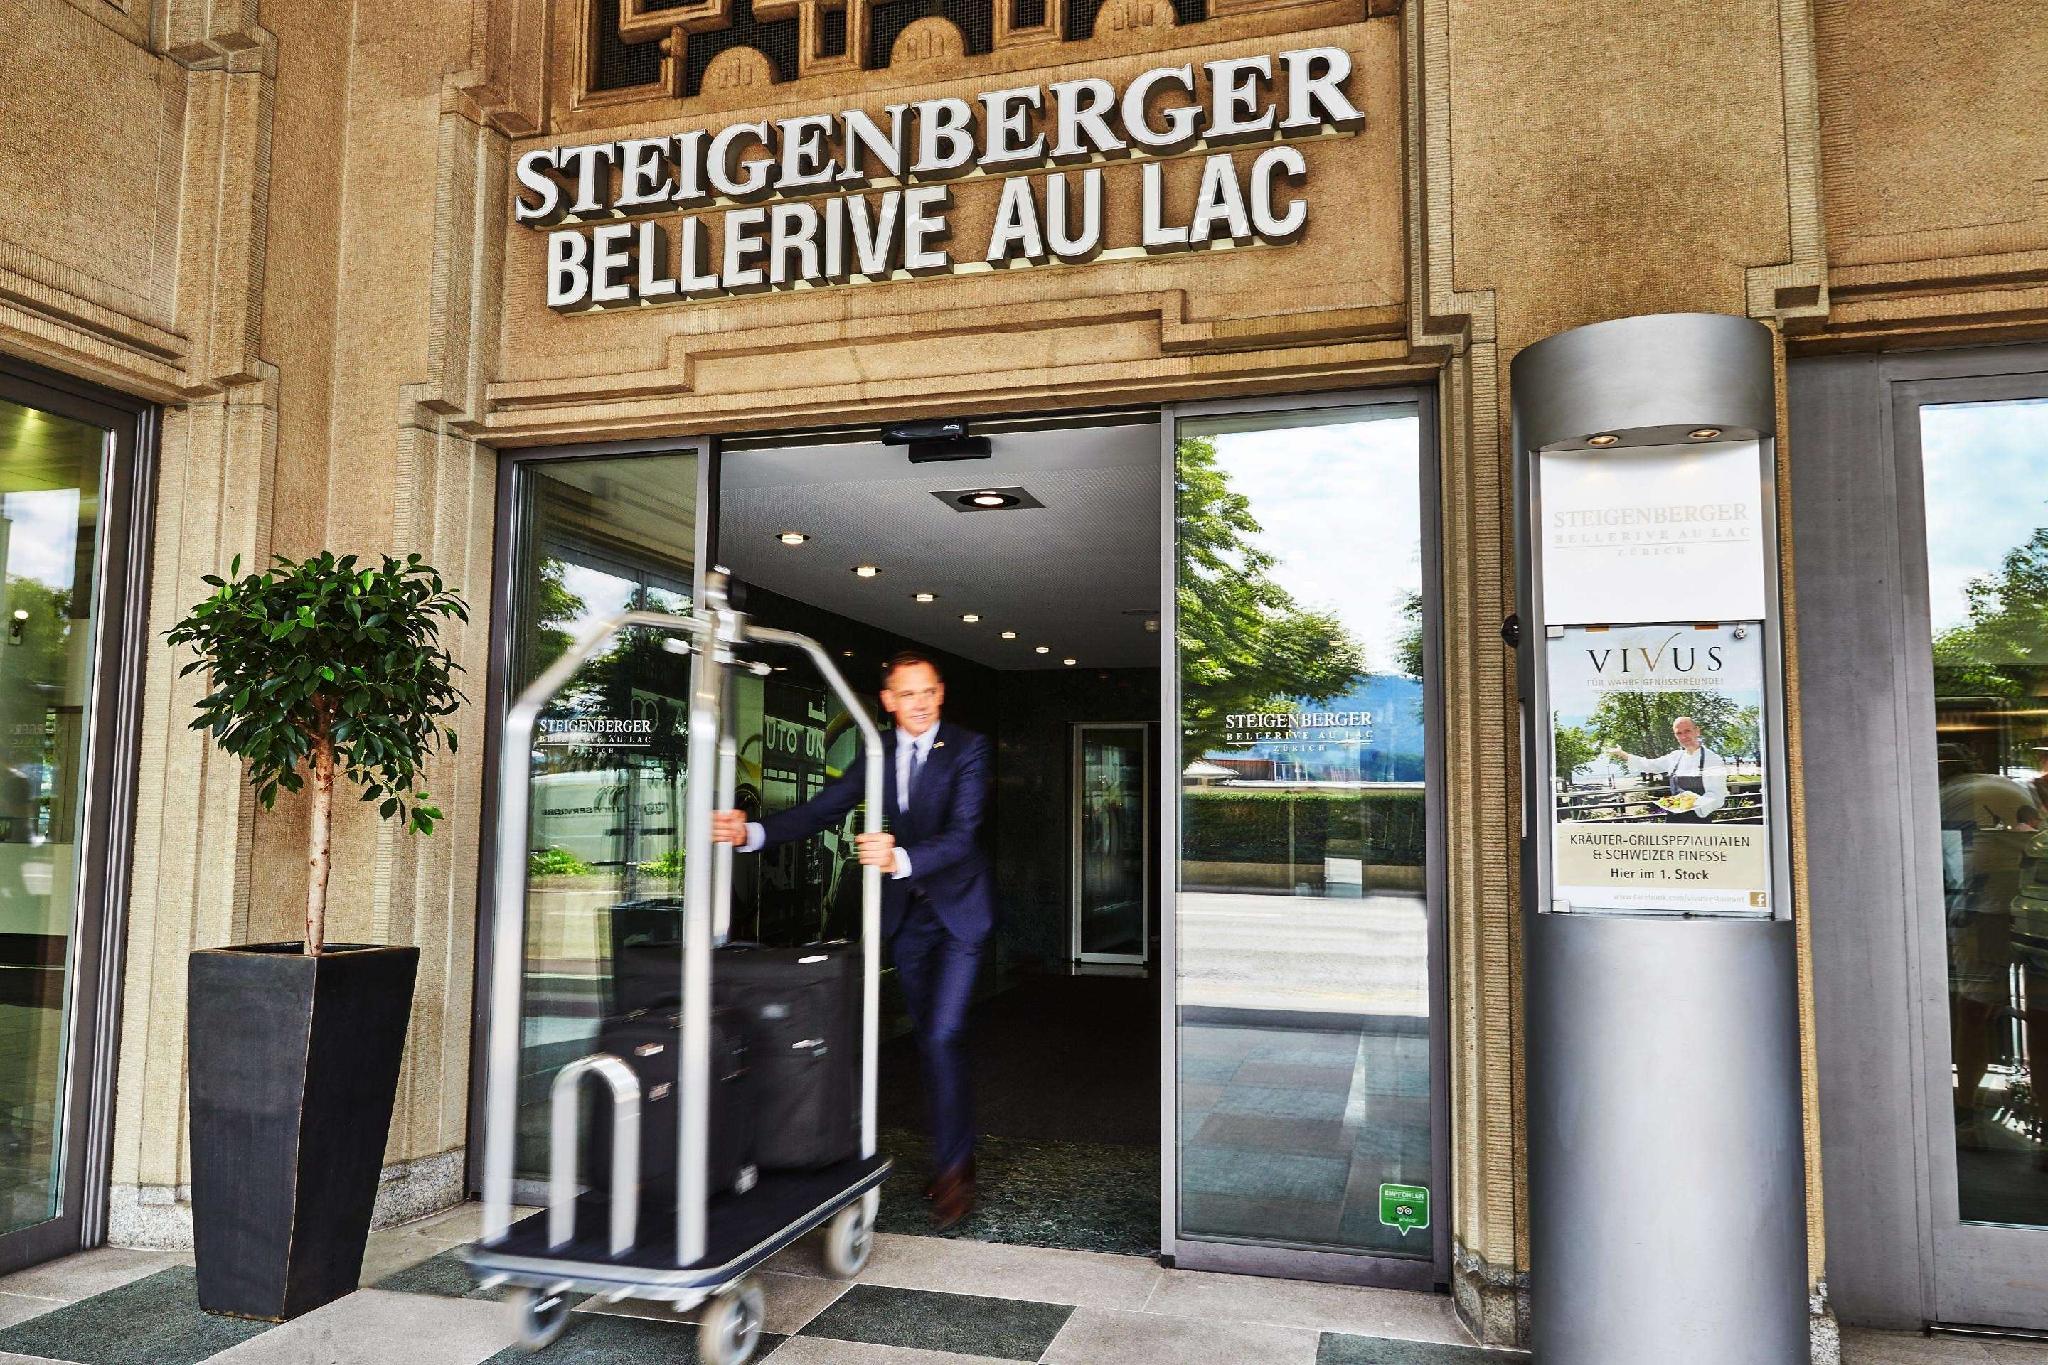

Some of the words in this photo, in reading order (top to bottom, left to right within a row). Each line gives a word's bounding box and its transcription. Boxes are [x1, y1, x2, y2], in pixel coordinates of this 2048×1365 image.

[514, 46, 1364, 223] STEIGENBERGER
[547, 184, 949, 308] BELLERIVE
[985, 168, 1102, 261] AU
[1143, 146, 1308, 251] LAC
[1554, 502, 1749, 528] STEIGENBERGER
[1555, 529, 1669, 544] BELLERIVE
[1679, 527, 1702, 539] AU
[1712, 527, 1750, 538] LAC
[1586, 633, 1722, 673] VIVUS
[1608, 678, 1640, 687] WAHRE
[540, 719, 651, 733] STEIGENBERGER
[1226, 711, 1372, 729] STEIGENBERGER
[629, 735, 652, 743] LAC
[1226, 731, 1309, 741] BELLERIVE
[1318, 731, 1336, 739] AU
[1570, 833, 1750, 847] KRÄUTER-GRILLSPEZIALITÄTEN
[1593, 850, 1602, 860] &
[1605, 850, 1674, 860] SCHWEIZER
[1679, 850, 1728, 861] FINESSE
[1610, 868, 1636, 878] Hier
[1640, 868, 1655, 879] im
[1661, 869, 1671, 879] 1.
[1674, 868, 1710, 880] Stock
